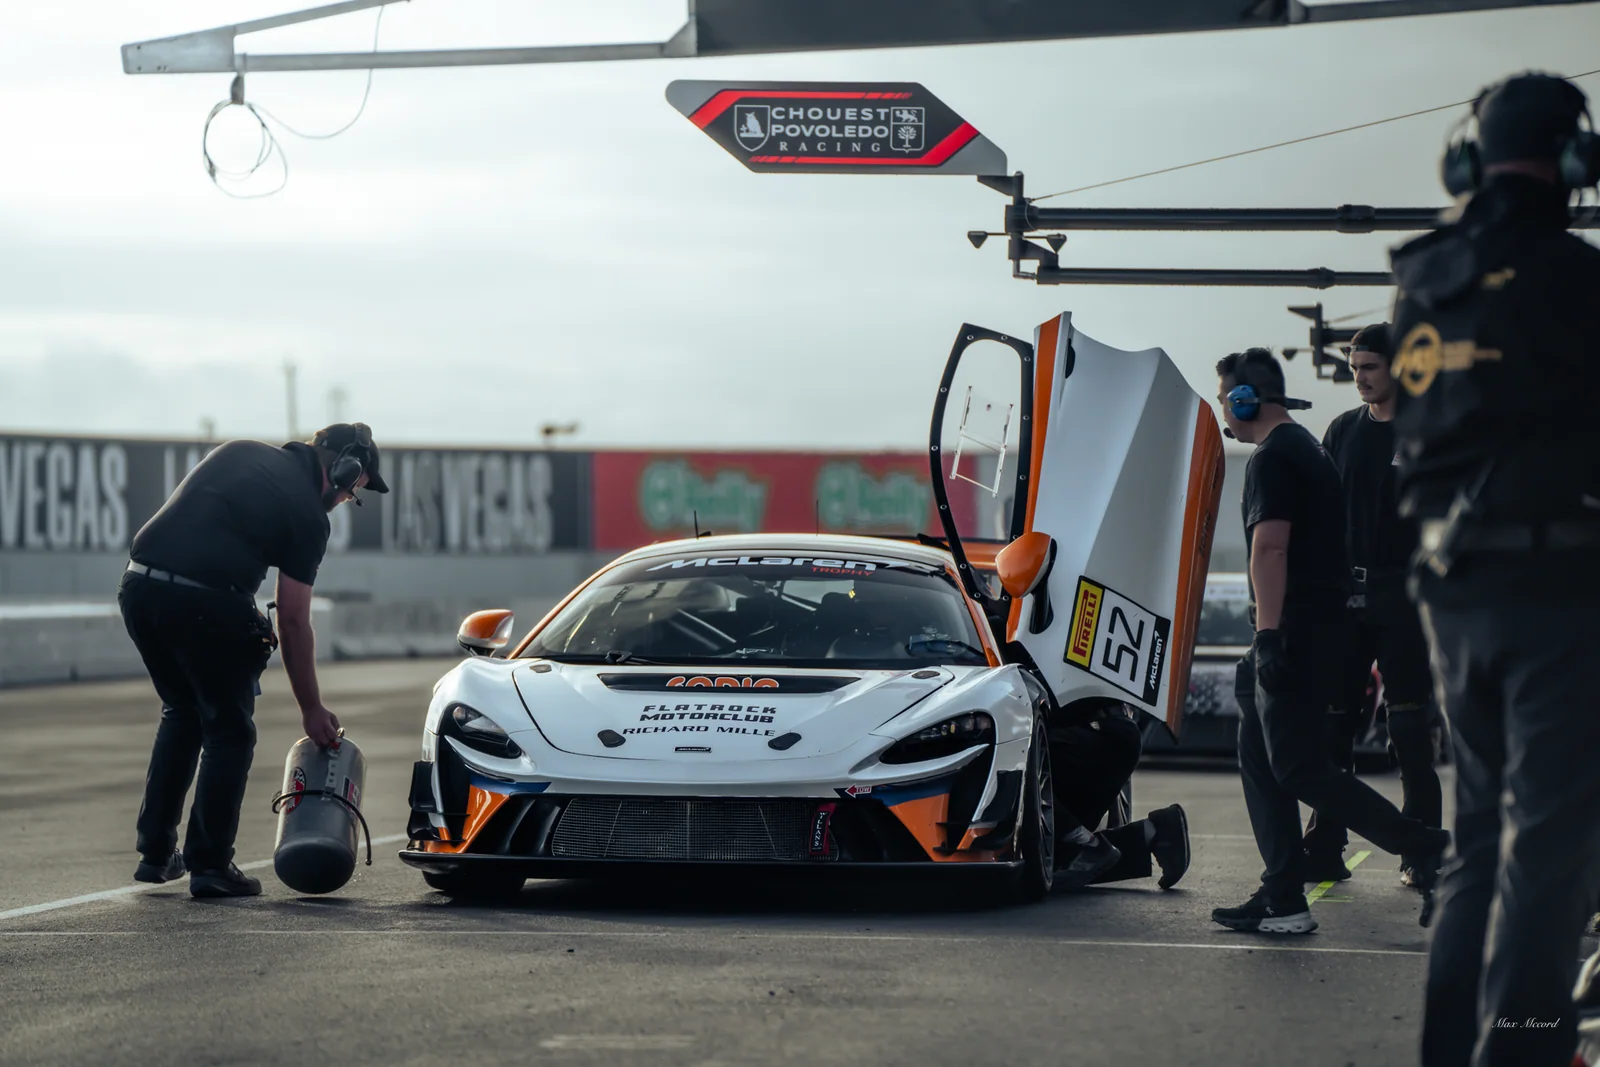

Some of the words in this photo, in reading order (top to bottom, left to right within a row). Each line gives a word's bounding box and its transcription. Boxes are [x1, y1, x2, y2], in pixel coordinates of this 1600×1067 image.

[771, 107, 889, 121] CHOUEST
[771, 124, 889, 138] POVOLEDO
[779, 140, 881, 152] RACING
[0, 441, 128, 549] VEGAS
[441, 452, 552, 552] VEGAS
[811, 567, 873, 576] TROPHY
[1072, 589, 1097, 658] PIRELLI
[1102, 606, 1144, 682] 52
[643, 703, 777, 714] FLATROCK
[639, 712, 774, 723] MOTORCLUB
[622, 725, 709, 735] RICHARD
[717, 726, 775, 737] MILLE
